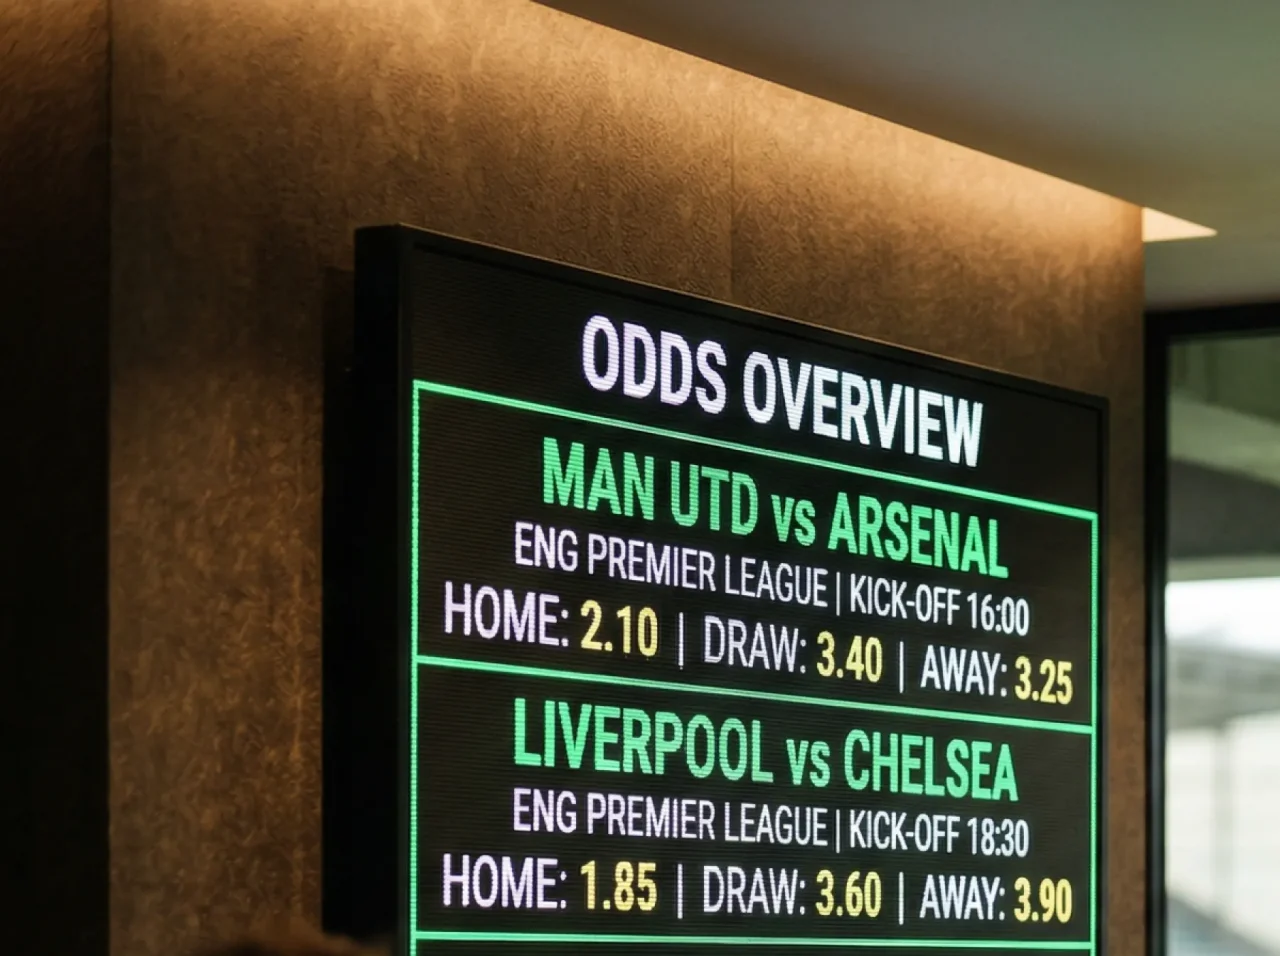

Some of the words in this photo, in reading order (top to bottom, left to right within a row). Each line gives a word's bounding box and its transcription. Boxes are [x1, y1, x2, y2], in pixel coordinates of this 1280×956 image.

[582, 315, 727, 415] ODDS
[743, 351, 984, 468] OVERVIEW
[543, 436, 655, 521] MAN
[670, 460, 759, 536] UTD
[770, 494, 816, 547] vs
[827, 491, 1009, 579] ARSENAL
[514, 521, 579, 572] ENG
[588, 533, 717, 592] PREMIER
[724, 554, 829, 608] LEAGUE
[850, 573, 962, 626] KICK-OFF
[966, 592, 1030, 637] 16:00
[444, 580, 569, 647] HOME:
[580, 599, 658, 657] 2.10
[704, 615, 807, 674] DRAW:
[816, 630, 883, 683] 3.40
[920, 644, 1008, 698] AWAY:
[1014, 655, 1073, 705] 3.25
[513, 697, 774, 783] LIVERPOOL
[785, 738, 831, 788] vs
[843, 728, 1019, 802] CHELSEA
[513, 787, 577, 834] ENG
[587, 792, 716, 840] PREMIER
[724, 801, 829, 847] LEAGUE
[849, 809, 961, 853] KICK-OFF
[966, 816, 1030, 858] 18:30
[442, 853, 567, 909] HOME:
[580, 860, 658, 911] 1.85
[703, 865, 806, 916] DRAW:
[815, 869, 882, 918] 3.60
[919, 873, 1006, 921] AWAY:
[1013, 876, 1073, 924] 3.90
